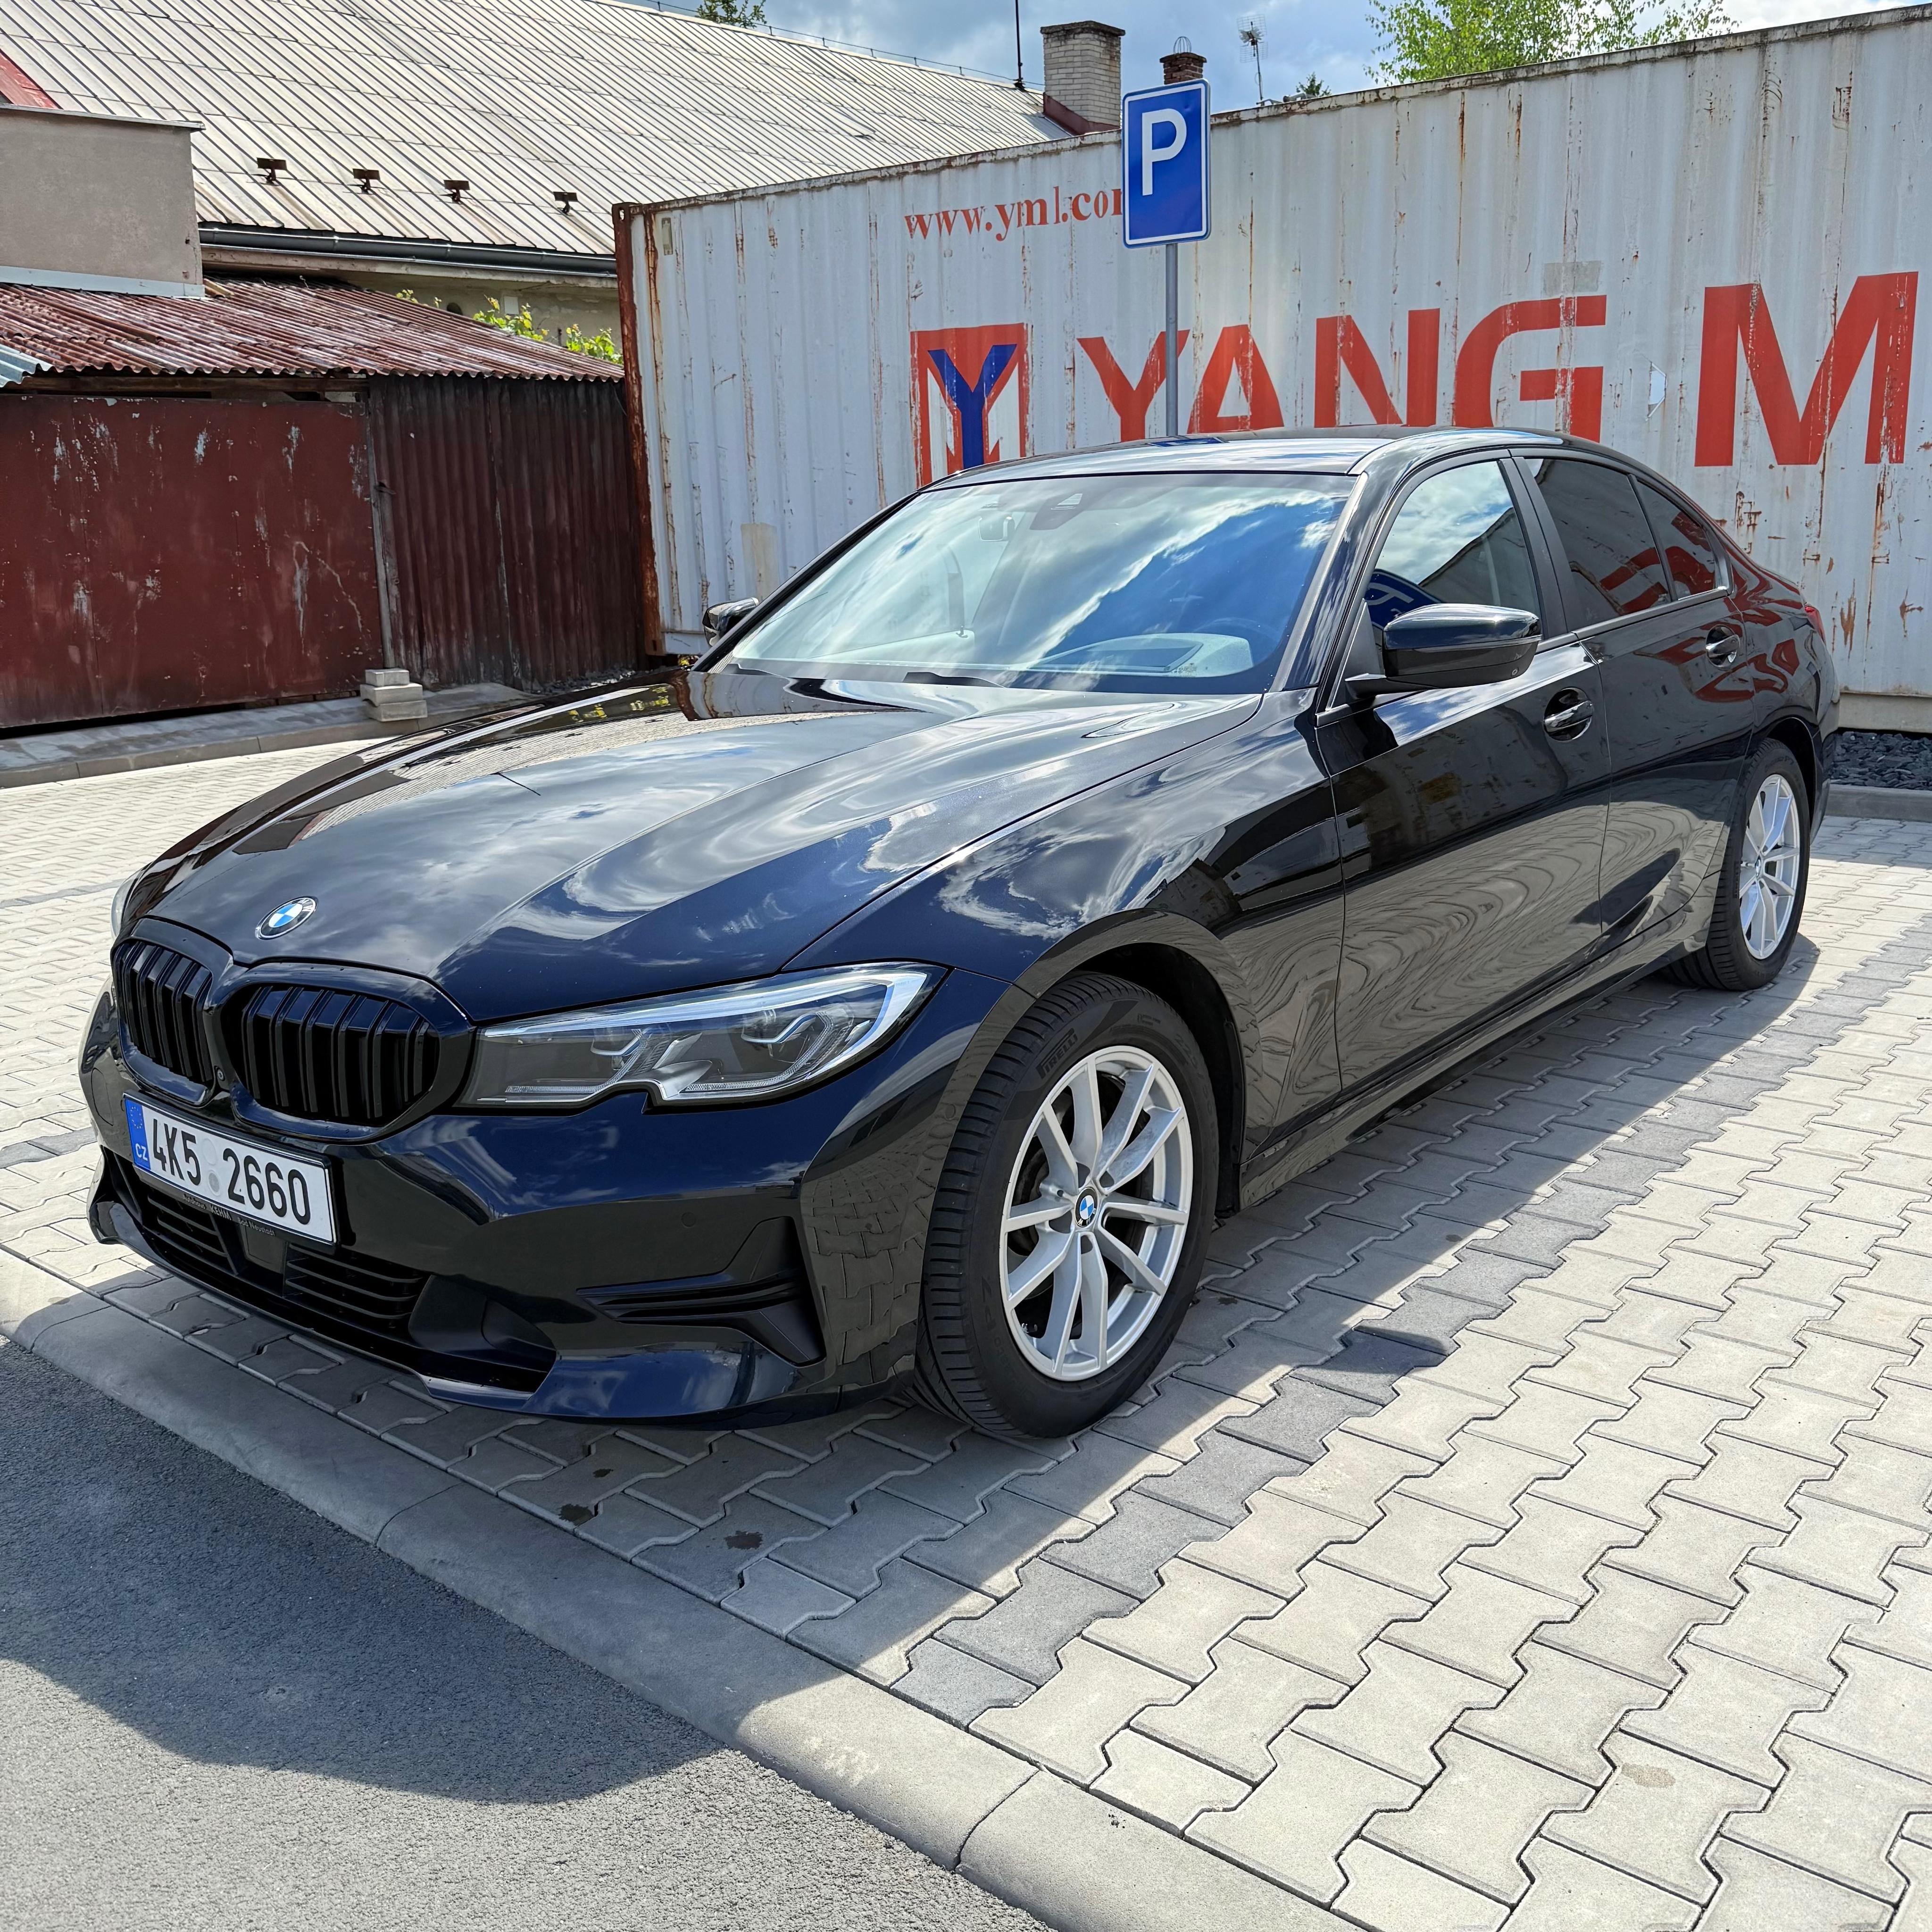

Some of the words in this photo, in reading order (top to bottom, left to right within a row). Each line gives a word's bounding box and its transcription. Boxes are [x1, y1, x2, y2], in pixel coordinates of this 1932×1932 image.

[1141, 108, 1188, 196] P
[1077, 294, 1607, 441] YANG
[1695, 271, 1919, 466] M
[135, 1142, 148, 1161] CZ
[153, 1118, 201, 1186] 4K5
[223, 1148, 311, 1225] 2660
